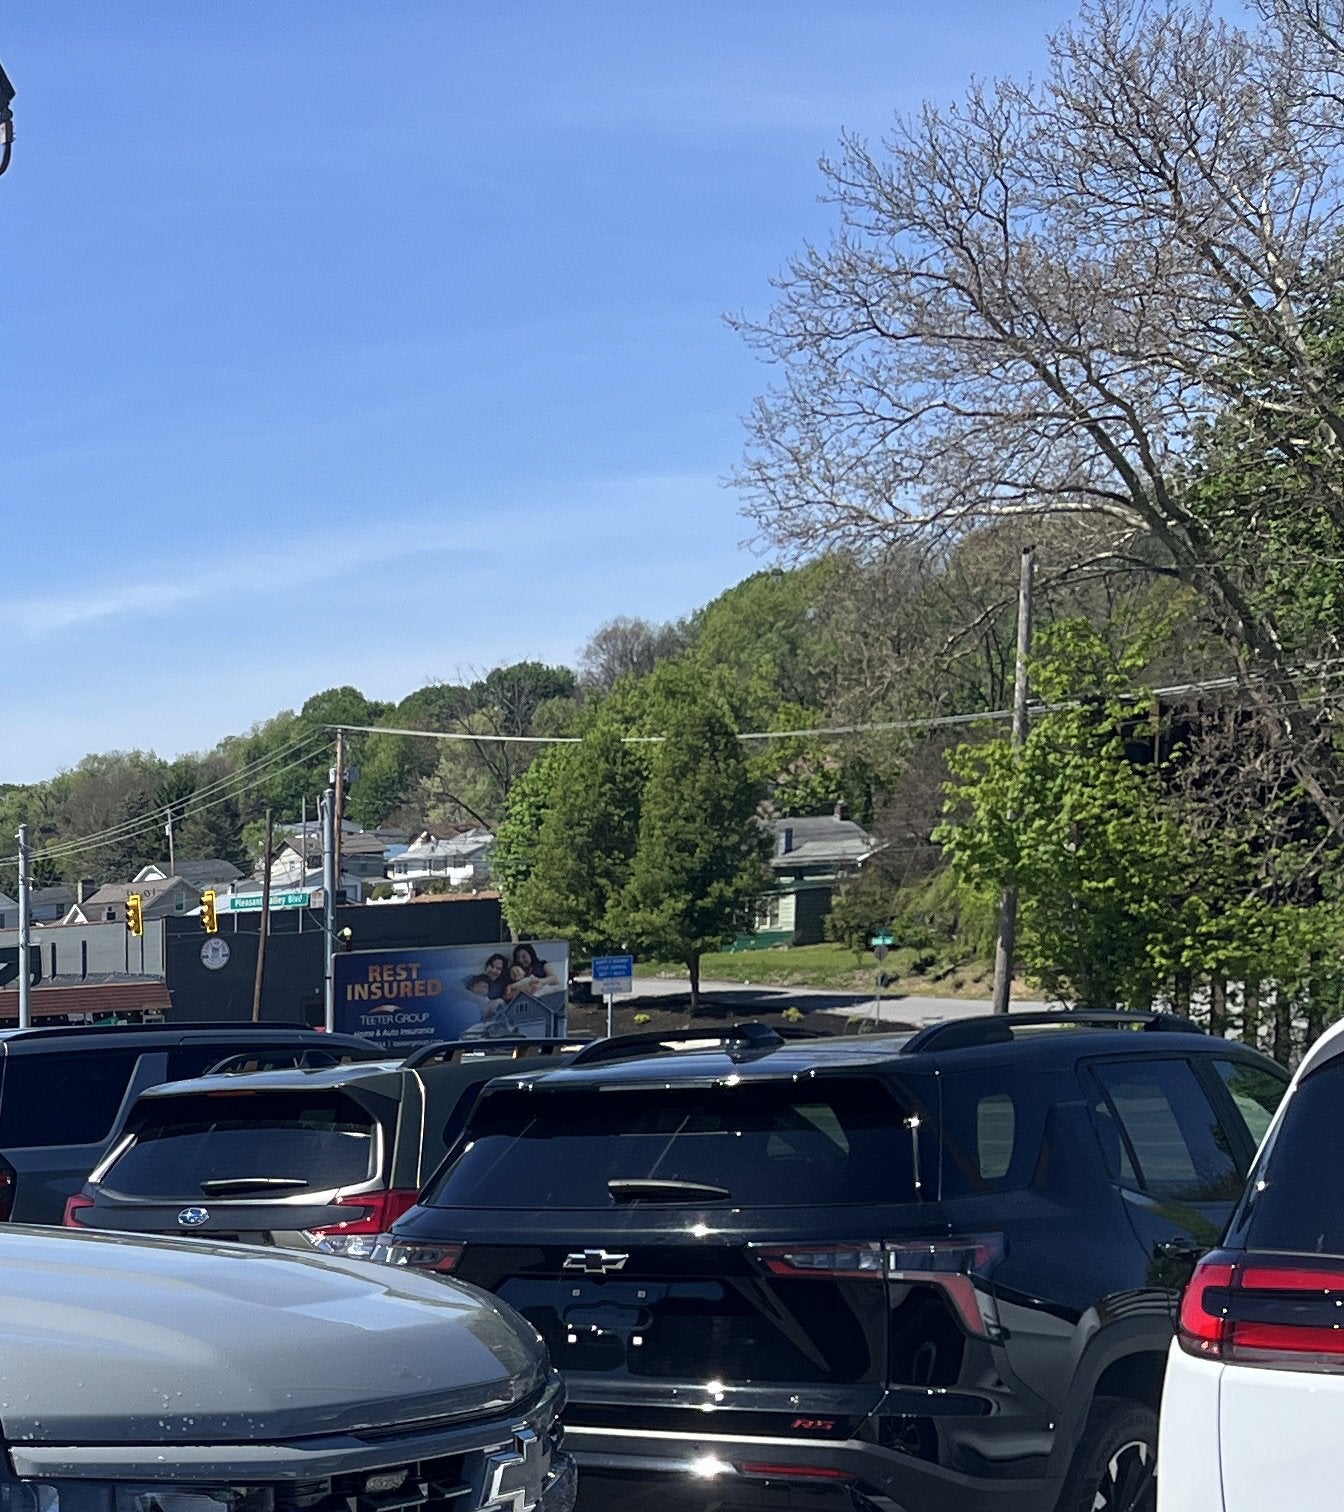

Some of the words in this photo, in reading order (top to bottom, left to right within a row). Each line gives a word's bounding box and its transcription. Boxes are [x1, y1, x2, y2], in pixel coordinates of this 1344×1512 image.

[368, 963, 421, 982] REST
[346, 979, 443, 1000] INSURED
[359, 1014, 394, 1025] TEETER
[395, 1012, 431, 1024] GROUP
[400, 1027, 435, 1035] Insurance
[791, 1418, 834, 1431] RS
